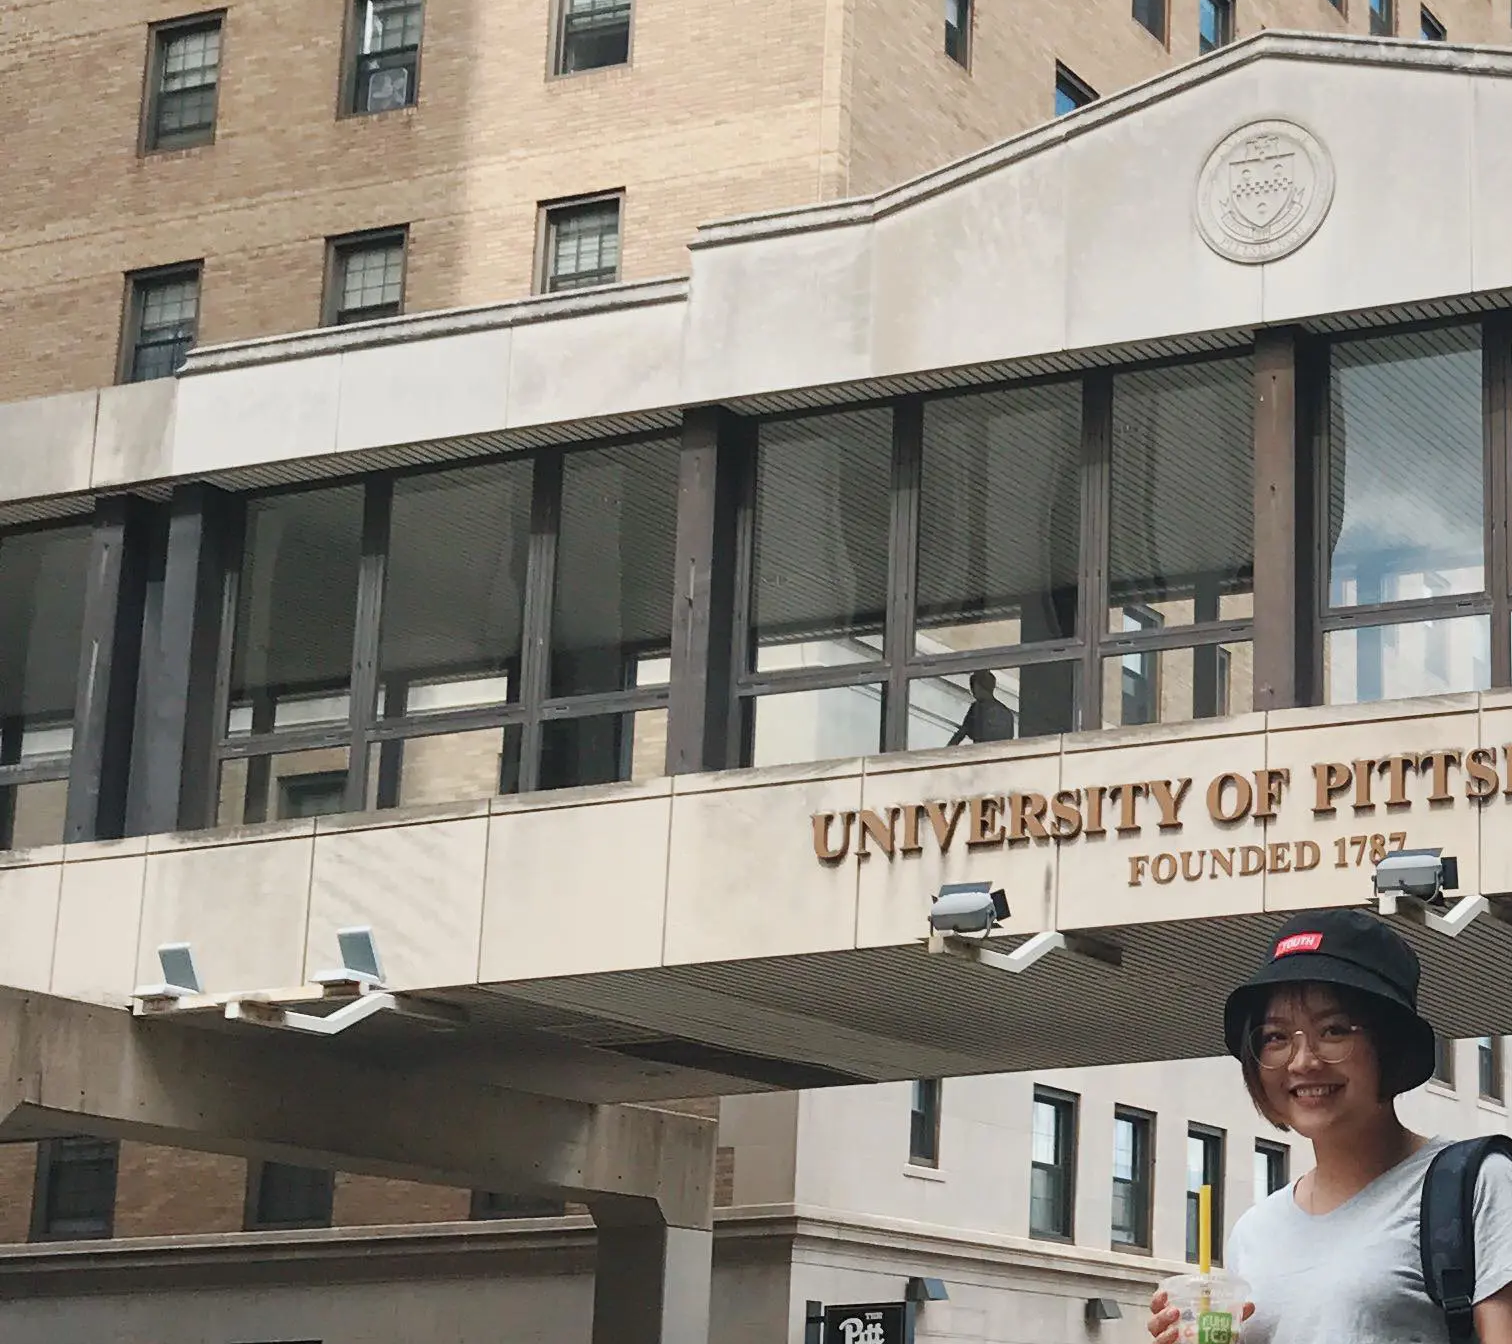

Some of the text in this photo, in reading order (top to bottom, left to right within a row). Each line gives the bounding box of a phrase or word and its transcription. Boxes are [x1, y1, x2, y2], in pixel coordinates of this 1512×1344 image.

[810, 776, 1194, 862] UNIVERSITY
[1205, 767, 1290, 822] OF
[1127, 831, 1407, 887] FOUNDED 1787
[1280, 936, 1316, 951] YOUTH
